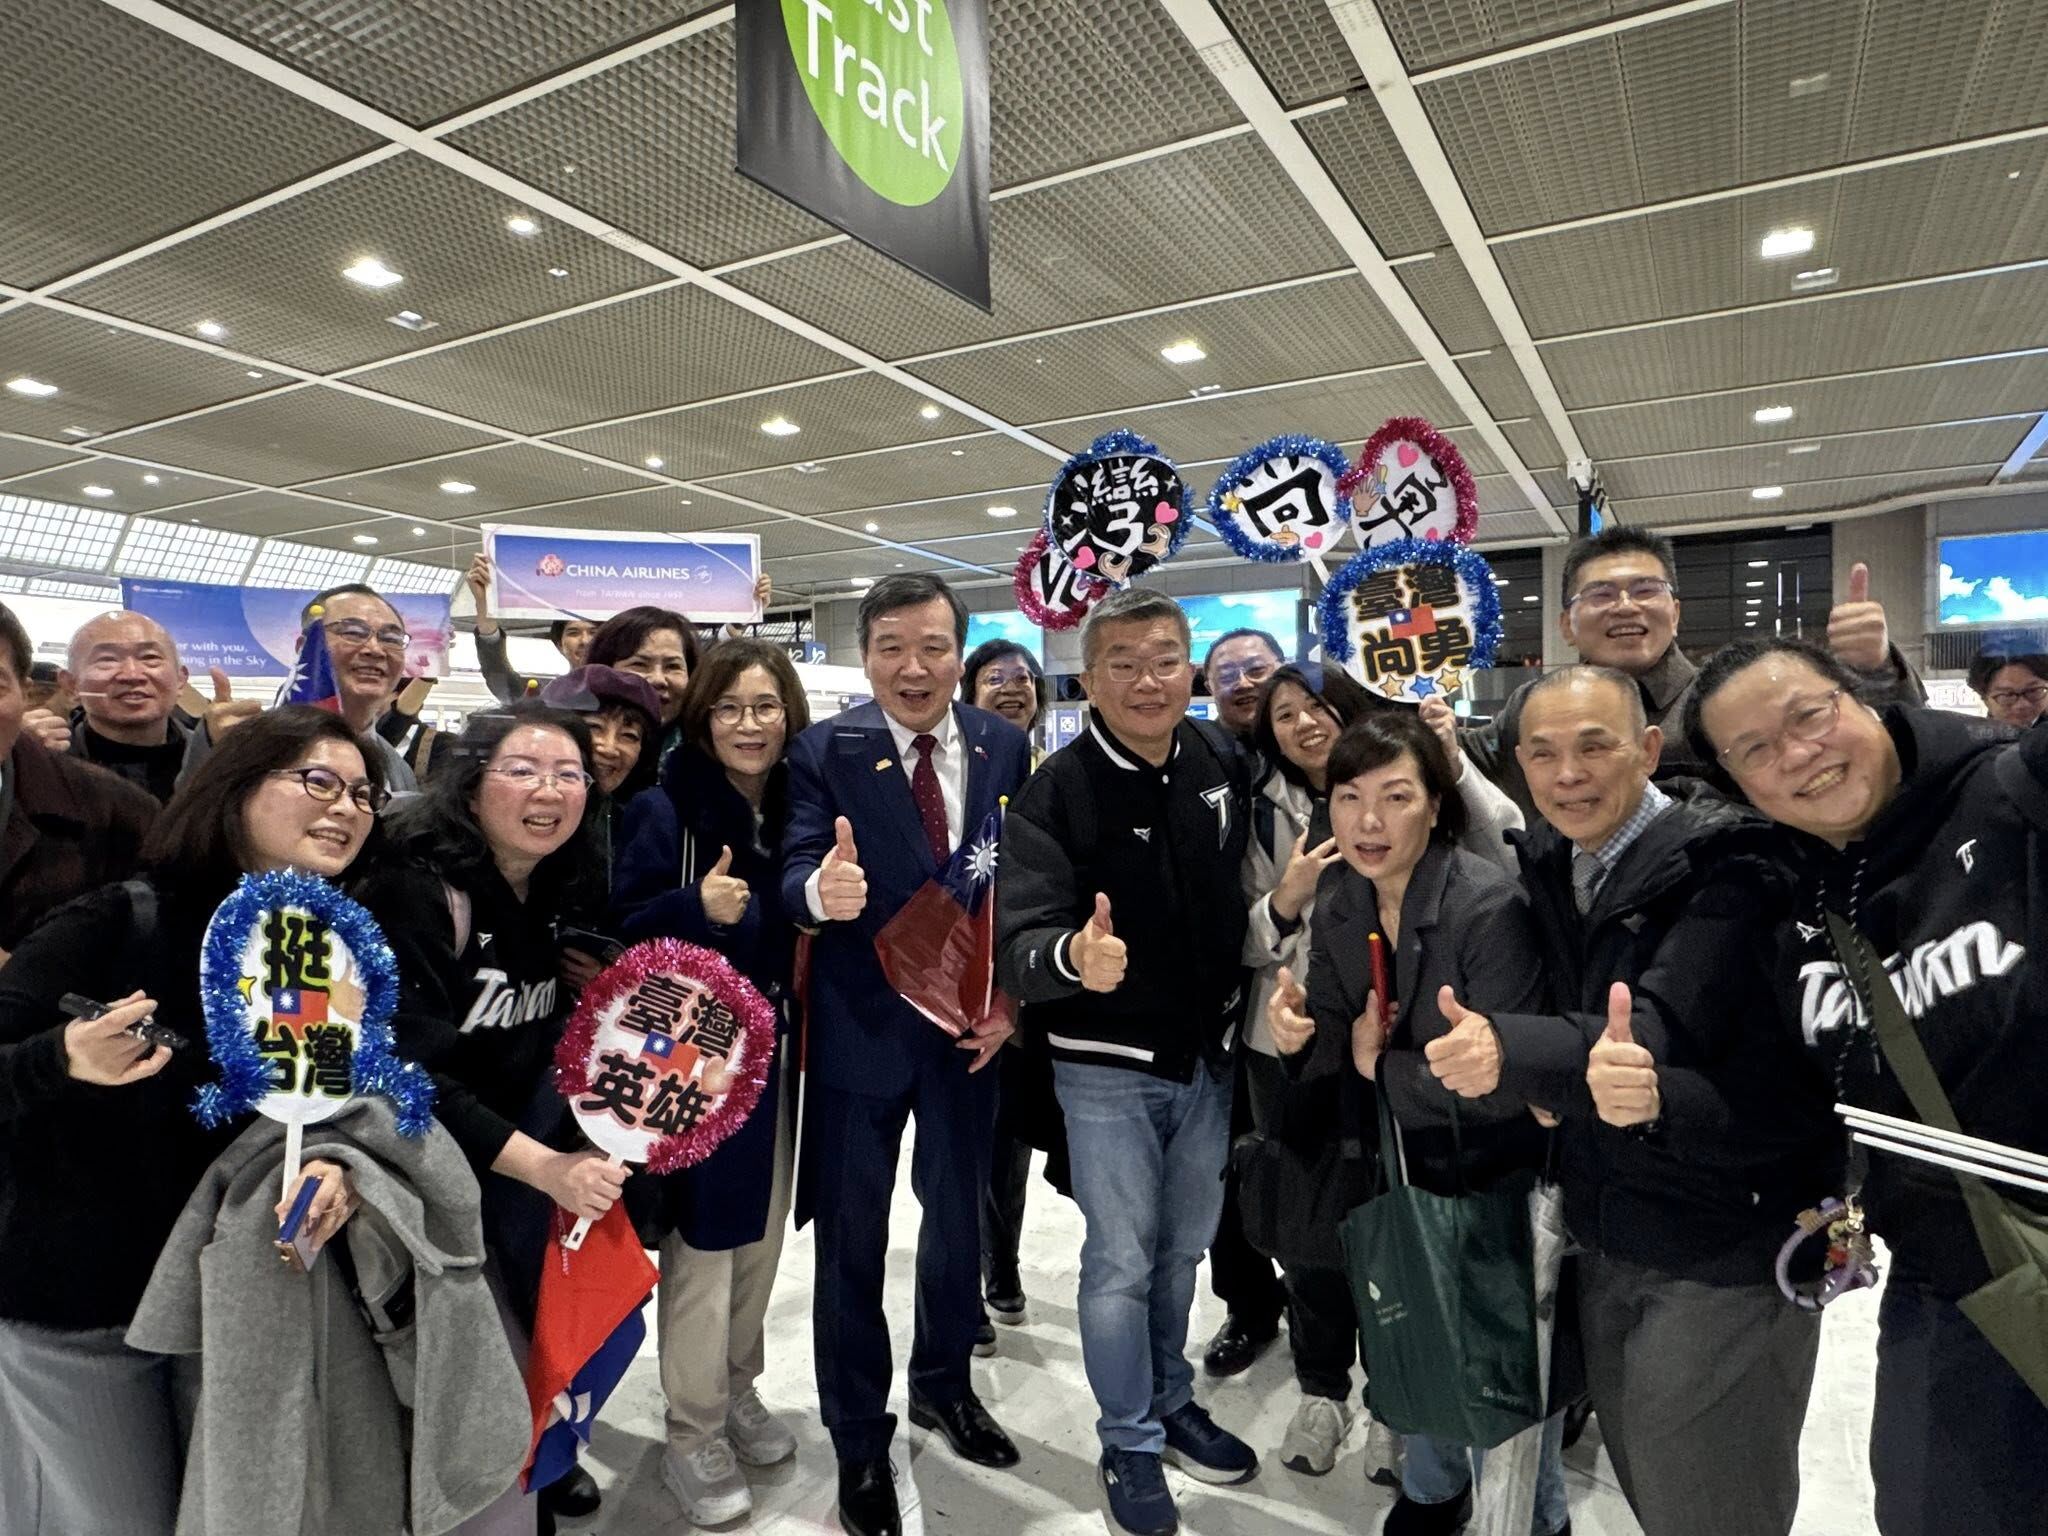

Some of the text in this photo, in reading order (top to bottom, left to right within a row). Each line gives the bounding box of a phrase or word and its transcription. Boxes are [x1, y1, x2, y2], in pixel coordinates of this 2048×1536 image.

[804, 0, 949, 172] Track
[1063, 458, 1159, 557] 灣
[1241, 456, 1329, 538] 尚
[1359, 459, 1448, 550] 勇
[566, 564, 690, 581] CHINA AIRLINES
[1354, 566, 1461, 621] 臺灣
[192, 641, 219, 651] with
[221, 643, 248, 654] you,
[223, 654, 242, 666] the
[246, 655, 267, 669] Sky
[1361, 616, 1473, 682] 尚勇
[264, 909, 331, 998] 挺
[255, 1019, 353, 1096] 台灣
[619, 974, 742, 1059] 臺灣
[580, 1053, 712, 1135] 英雄
